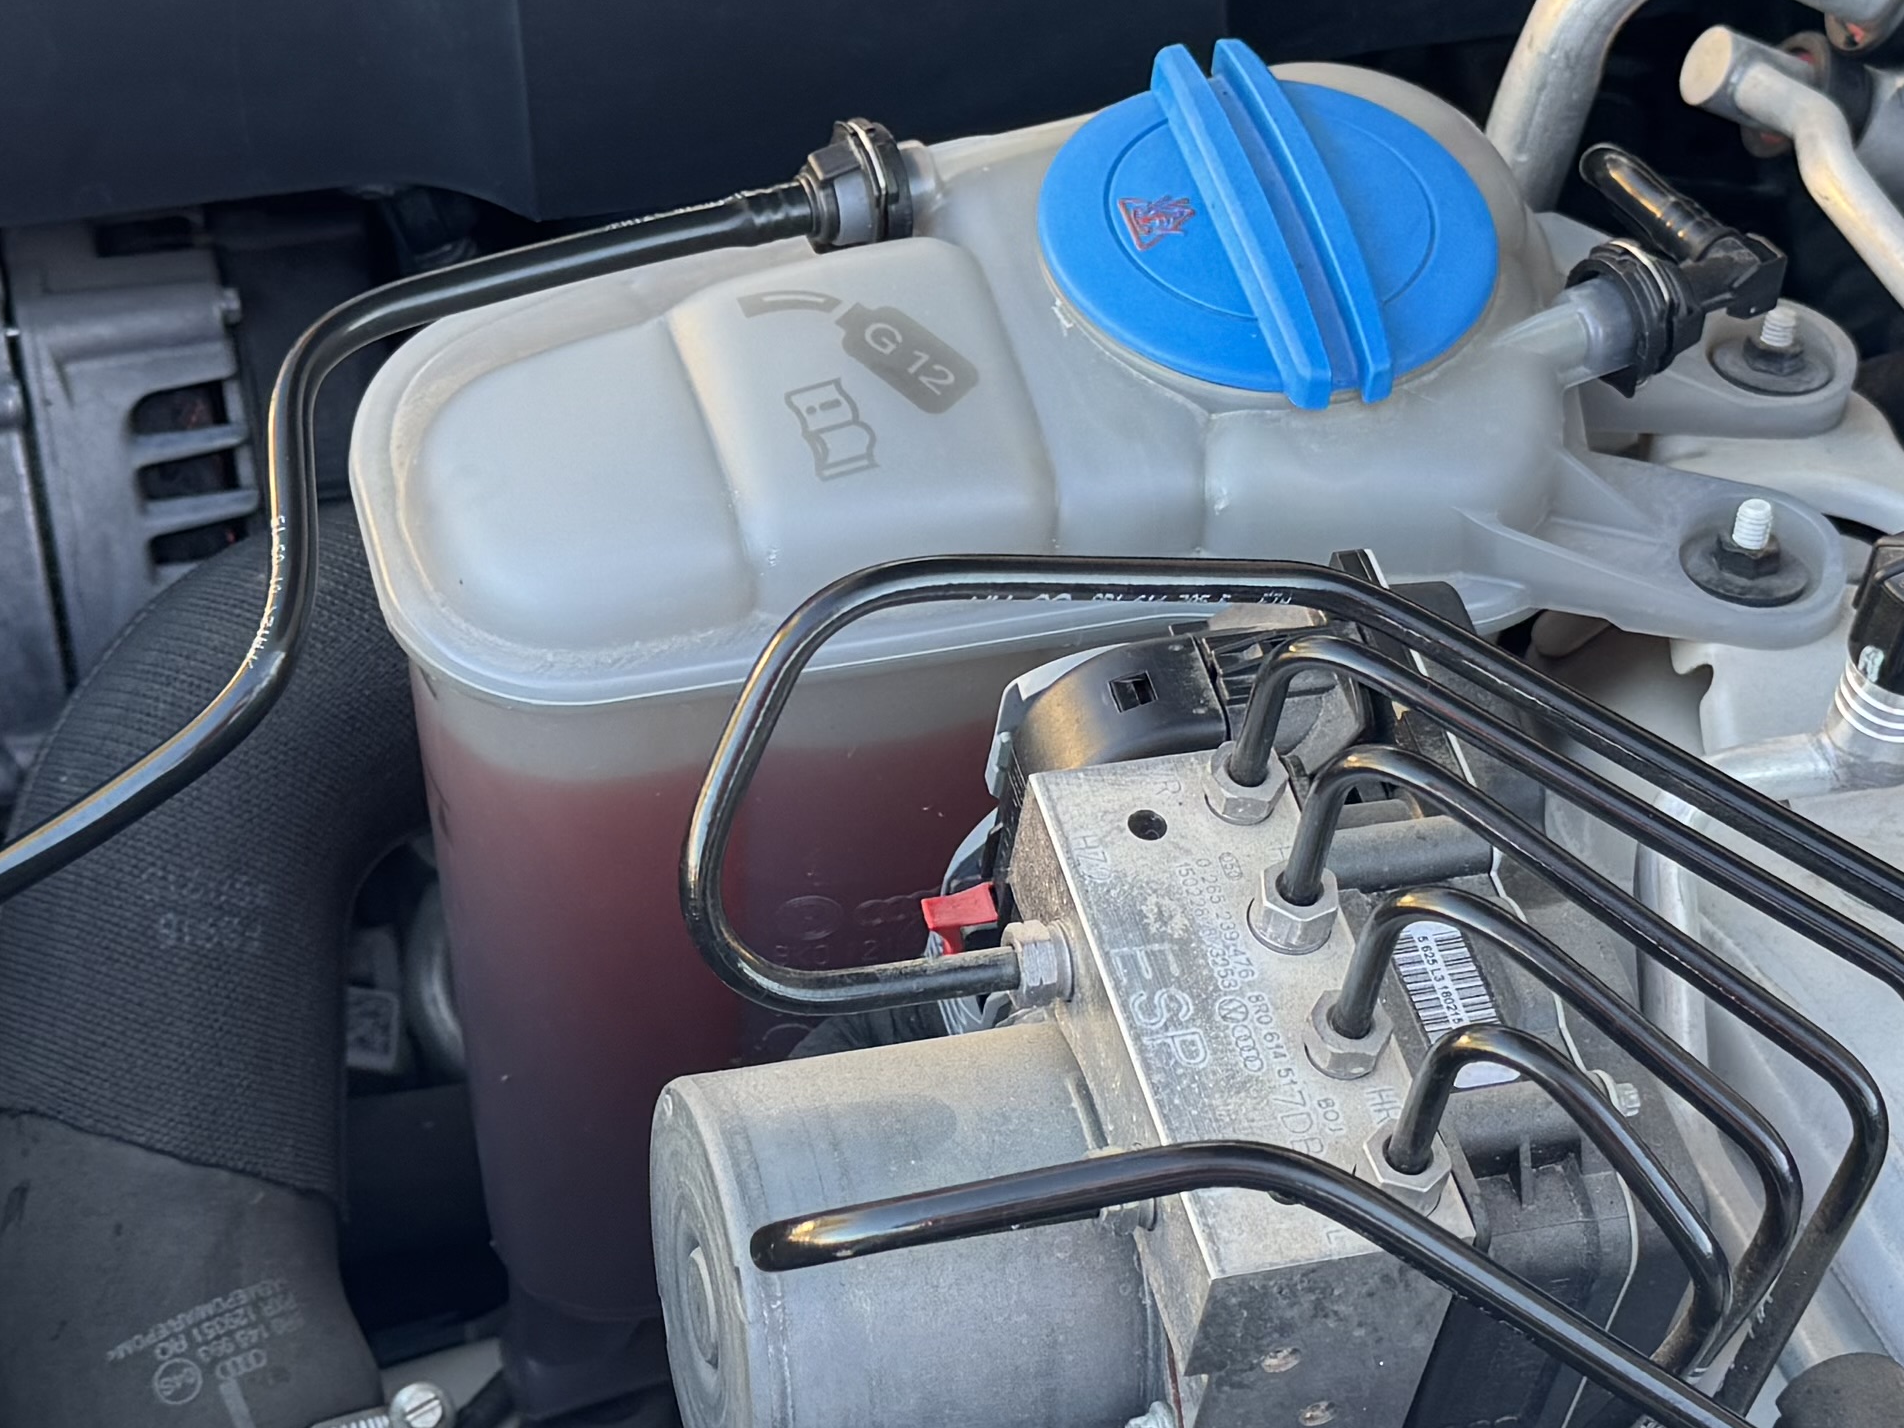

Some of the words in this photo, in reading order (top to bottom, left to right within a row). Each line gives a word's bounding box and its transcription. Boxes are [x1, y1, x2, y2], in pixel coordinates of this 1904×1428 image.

[863, 323, 904, 355] G
[903, 352, 957, 399] 12
[1199, 871, 1227, 907] 265
[1214, 908, 1242, 947] 239
[1228, 944, 1257, 982] 476
[1246, 991, 1274, 1030] 8R0
[1416, 934, 1428, 943] 5
[1420, 944, 1437, 966] 625
[1430, 966, 1445, 982] L3
[1107, 930, 1215, 1085] ESP
[1437, 983, 1464, 1025] 180215
